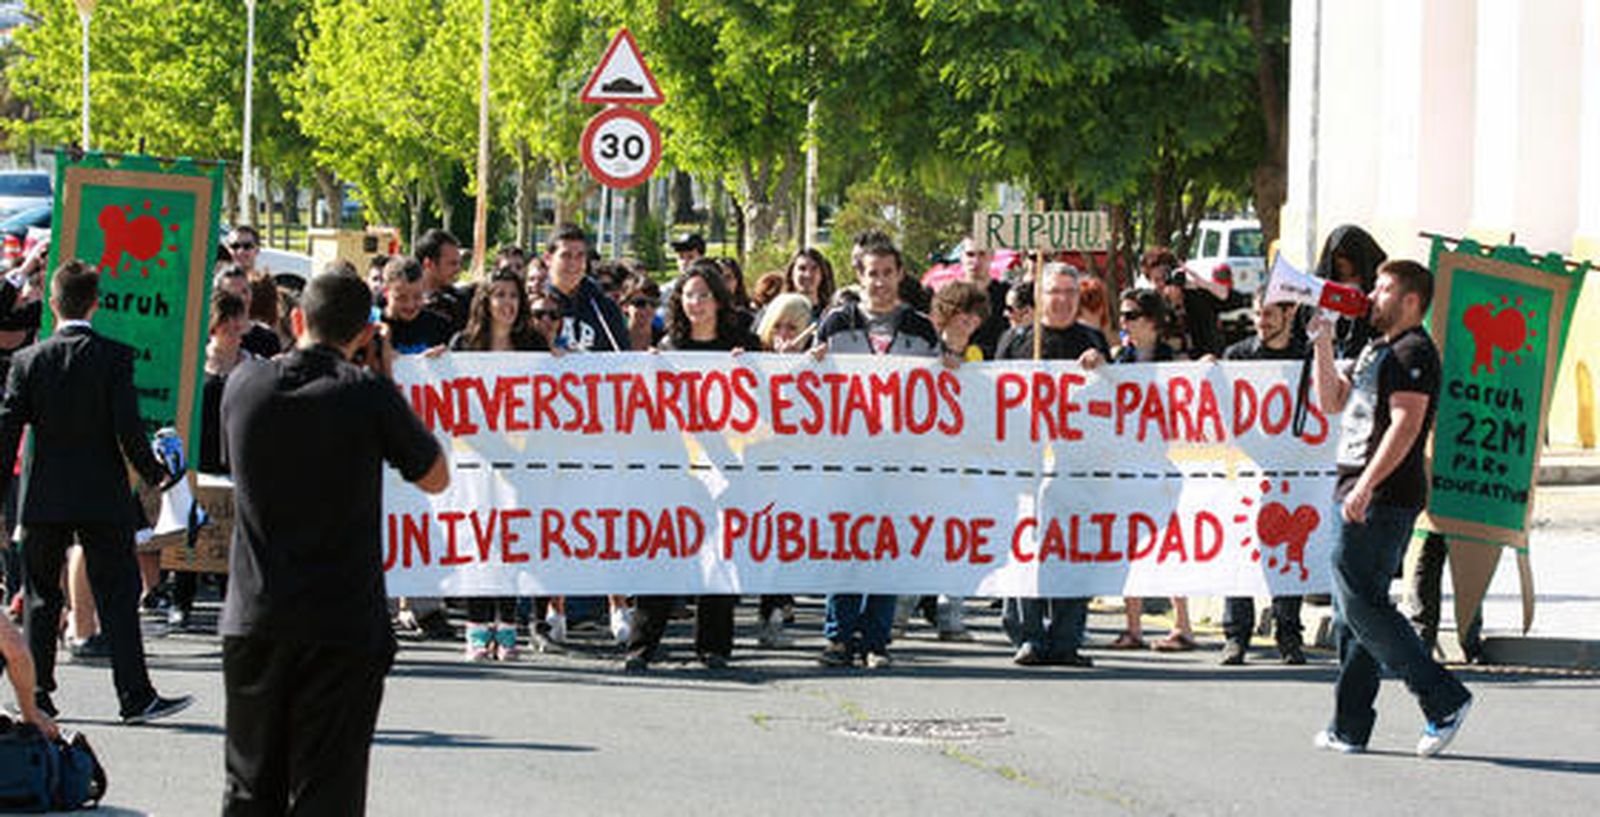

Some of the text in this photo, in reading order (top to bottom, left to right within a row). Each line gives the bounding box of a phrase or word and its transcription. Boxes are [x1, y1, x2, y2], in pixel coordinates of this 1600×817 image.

[601, 133, 644, 160] 30
[99, 292, 169, 317] aruh
[770, 368, 964, 436] ESTAMOS
[1448, 380, 1523, 412] caruh
[1456, 411, 1527, 456] 22M
[383, 502, 1225, 572] UNIVERSIDAD PÚBLICA Y DE CALIDAD
